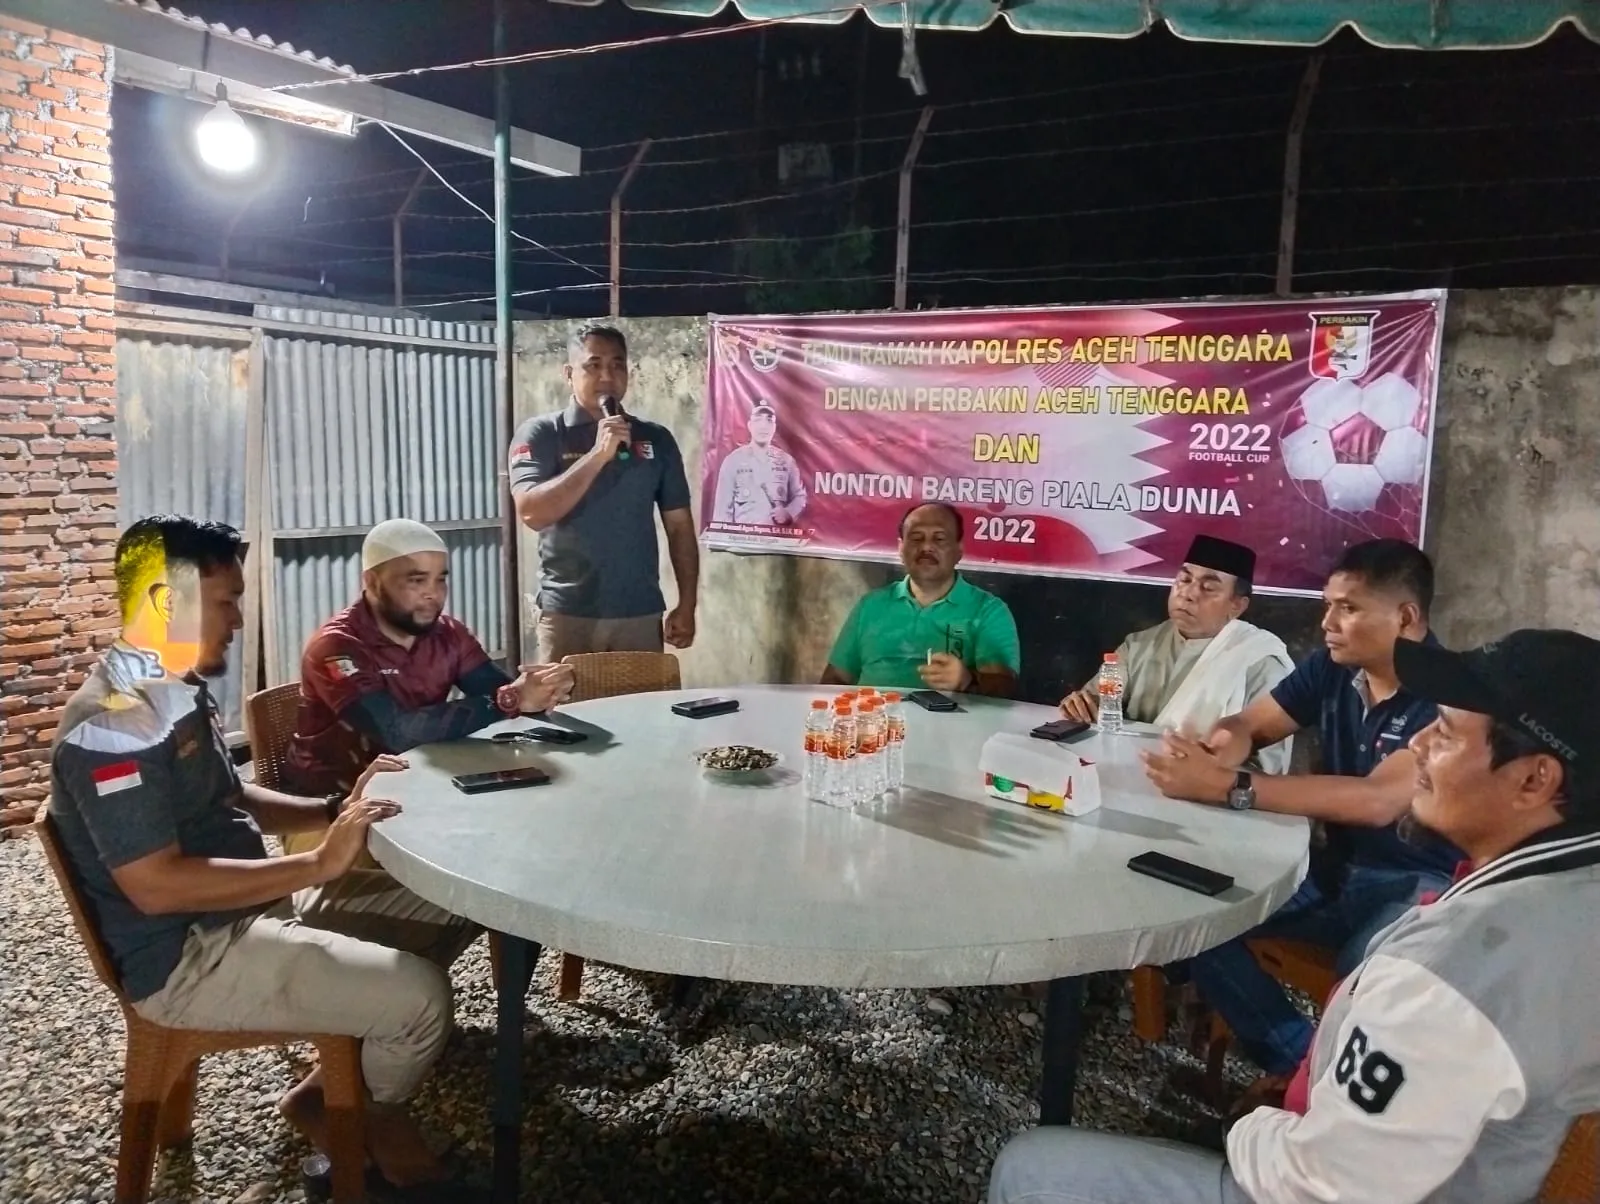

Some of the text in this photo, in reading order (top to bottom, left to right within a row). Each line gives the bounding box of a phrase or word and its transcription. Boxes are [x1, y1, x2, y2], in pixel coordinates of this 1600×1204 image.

[1320, 316, 1368, 324] PERBAKIN
[859, 339, 935, 366] RAMAH
[940, 337, 1064, 365] KAPOLRES
[1070, 336, 1138, 363] ACEH
[1145, 333, 1293, 363] TENGGARA
[824, 386, 1250, 415] DENGAN PERBAKIN ACEH TENGGARA
[973, 433, 1041, 464] DAN
[1189, 422, 1272, 451] 2022
[1188, 451, 1270, 463] FOOTBALL CUP
[814, 471, 1241, 516] NONTON BARENG PIALA DUNIA
[973, 516, 1036, 544] 2022
[1518, 712, 1579, 761] LACOSTE
[1335, 1025, 1405, 1114] 69
